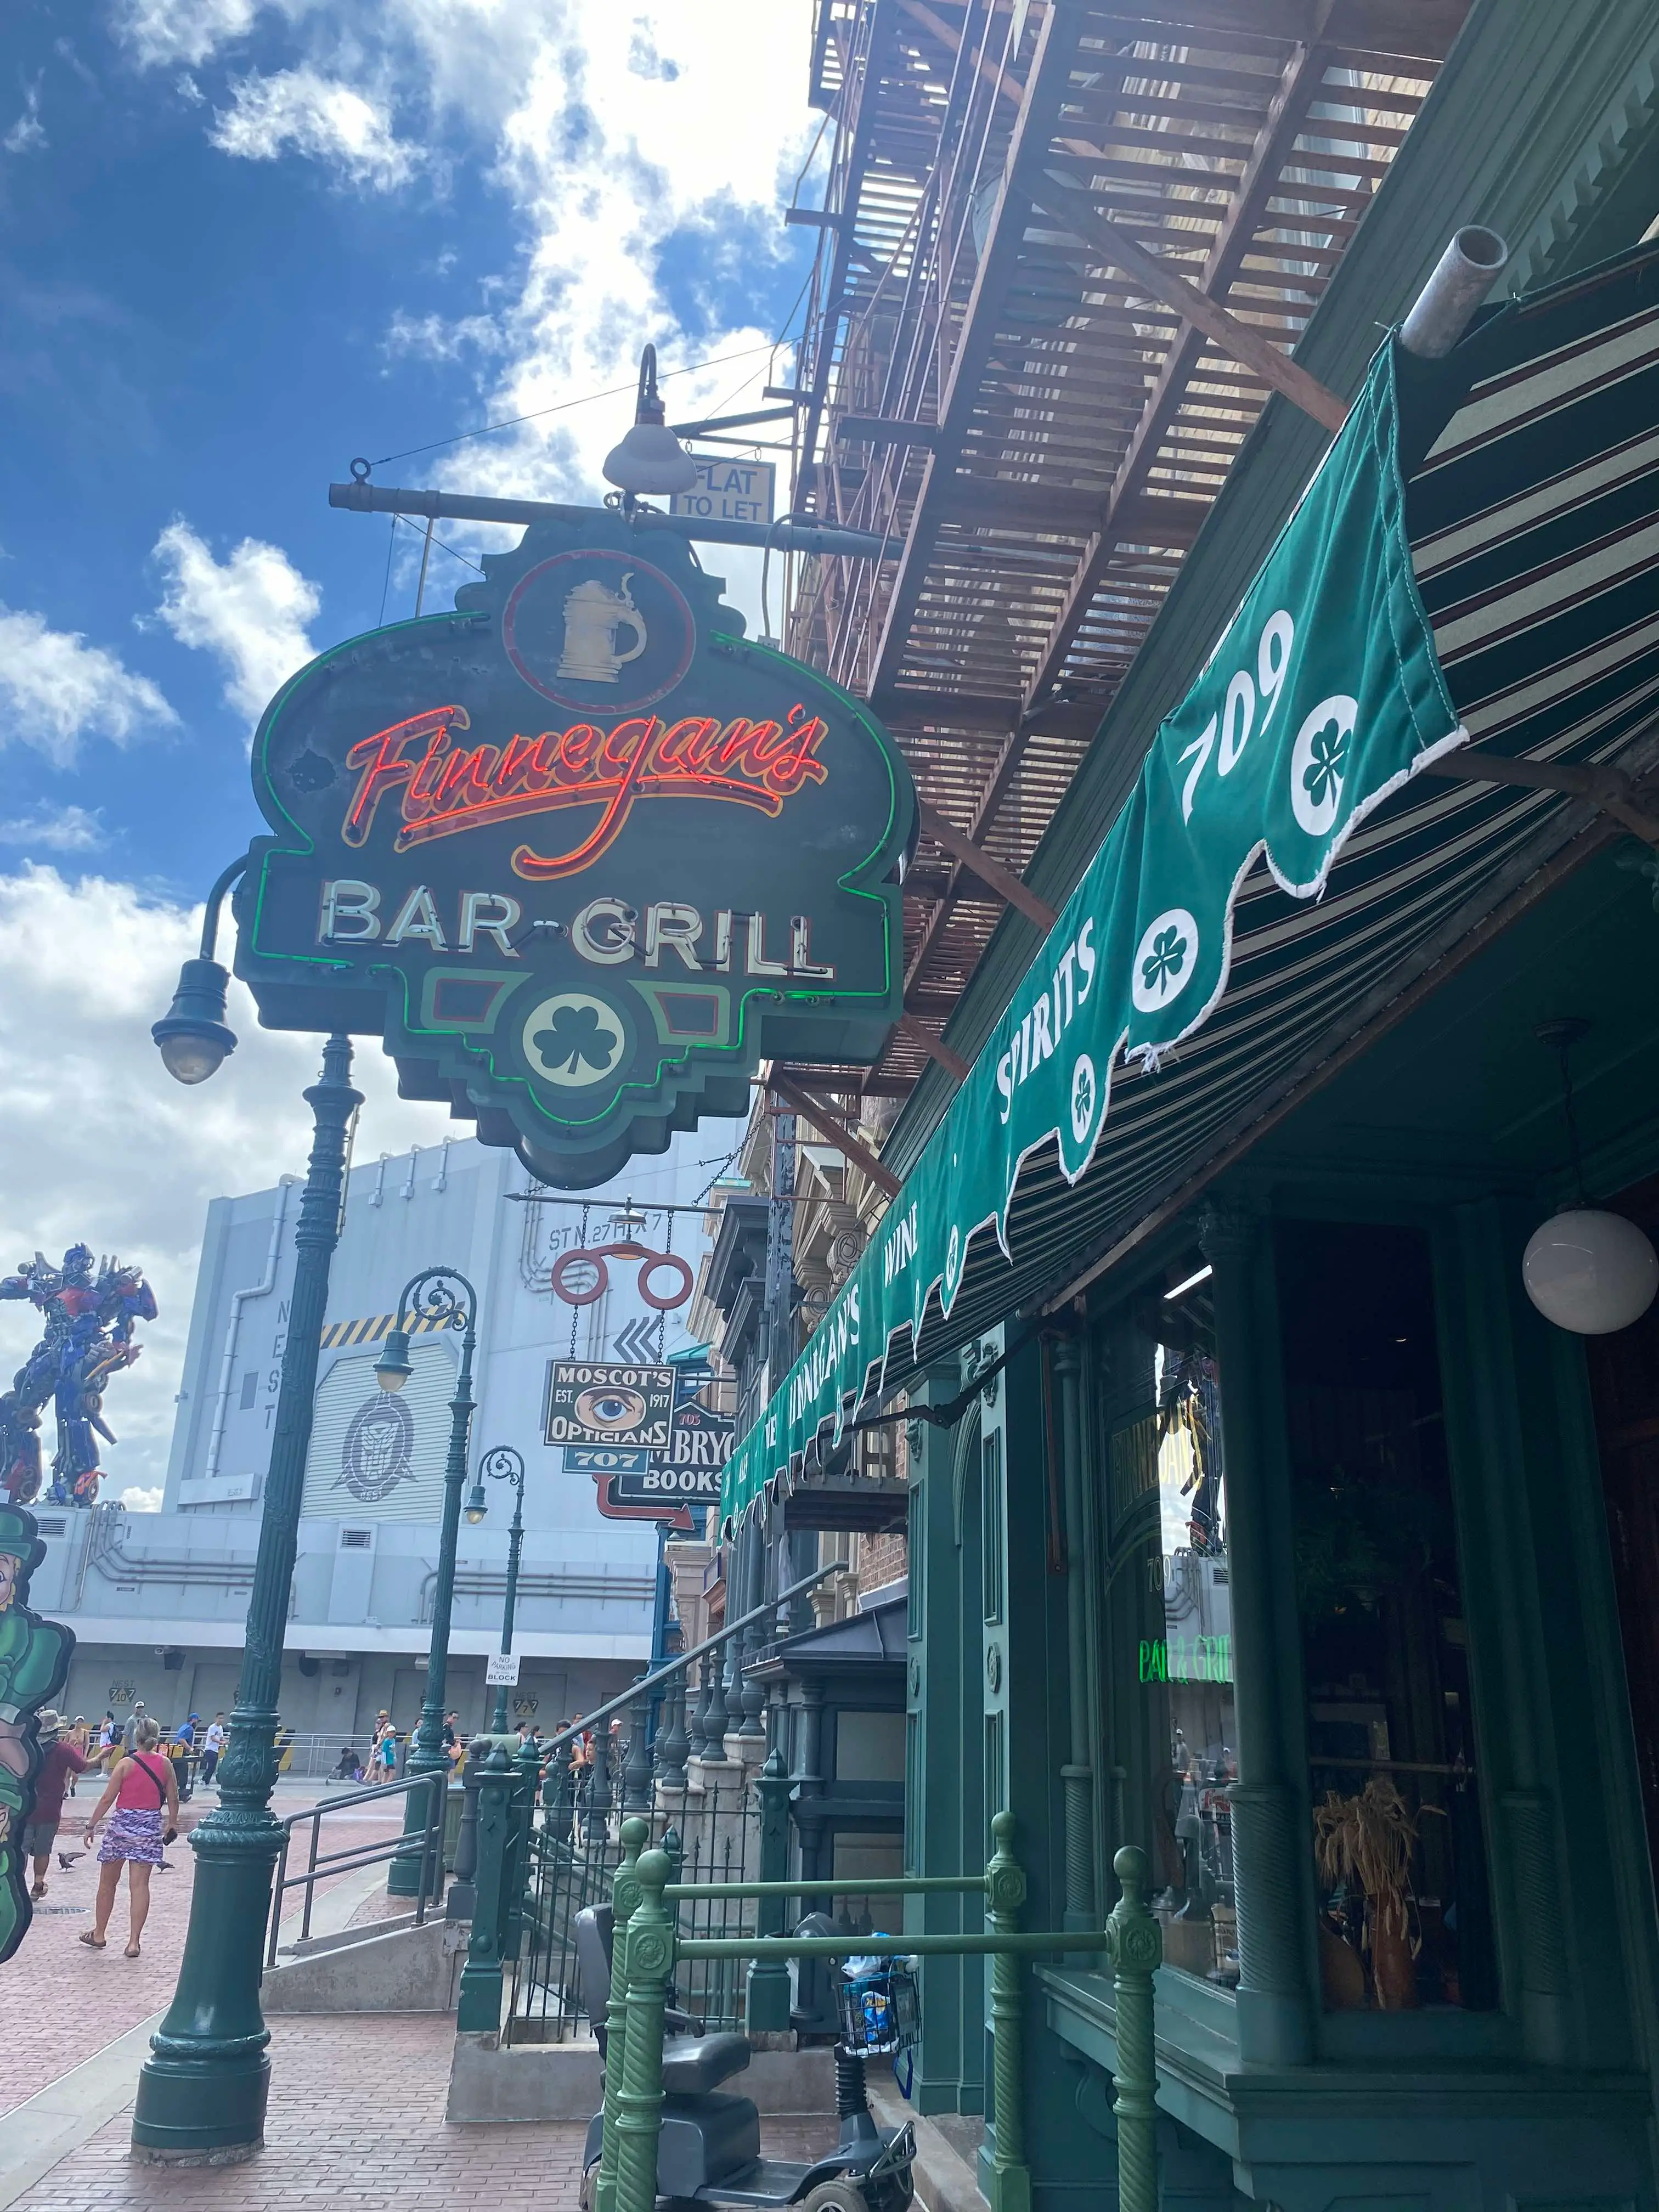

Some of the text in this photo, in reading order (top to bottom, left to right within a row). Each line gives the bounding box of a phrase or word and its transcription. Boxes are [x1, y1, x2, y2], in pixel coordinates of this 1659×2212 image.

[696, 465, 757, 494] LAT
[684, 495, 763, 521] TO LET
[1177, 610, 1294, 827] 709
[343, 703, 829, 880] Finnegan's
[996, 916, 1096, 1125] SPIRITS
[884, 1200, 918, 1288] WINE
[557, 1367, 672, 1387] MOSCOT'S
[555, 1389, 670, 1408] EST. 1917
[678, 1413, 701, 1426] 705
[551, 1416, 667, 1444] OPTICIANS
[575, 1451, 639, 1468] 707
[1147, 1556, 1171, 1592] 709
[492, 1661, 516, 1671] PARKING
[112, 1679, 135, 1687] NEST
[111, 1689, 135, 1697] 7 7
[116, 1694, 126, 1702] 10
[516, 1701, 521, 1709] 7
[523, 1705, 528, 1713] 7
